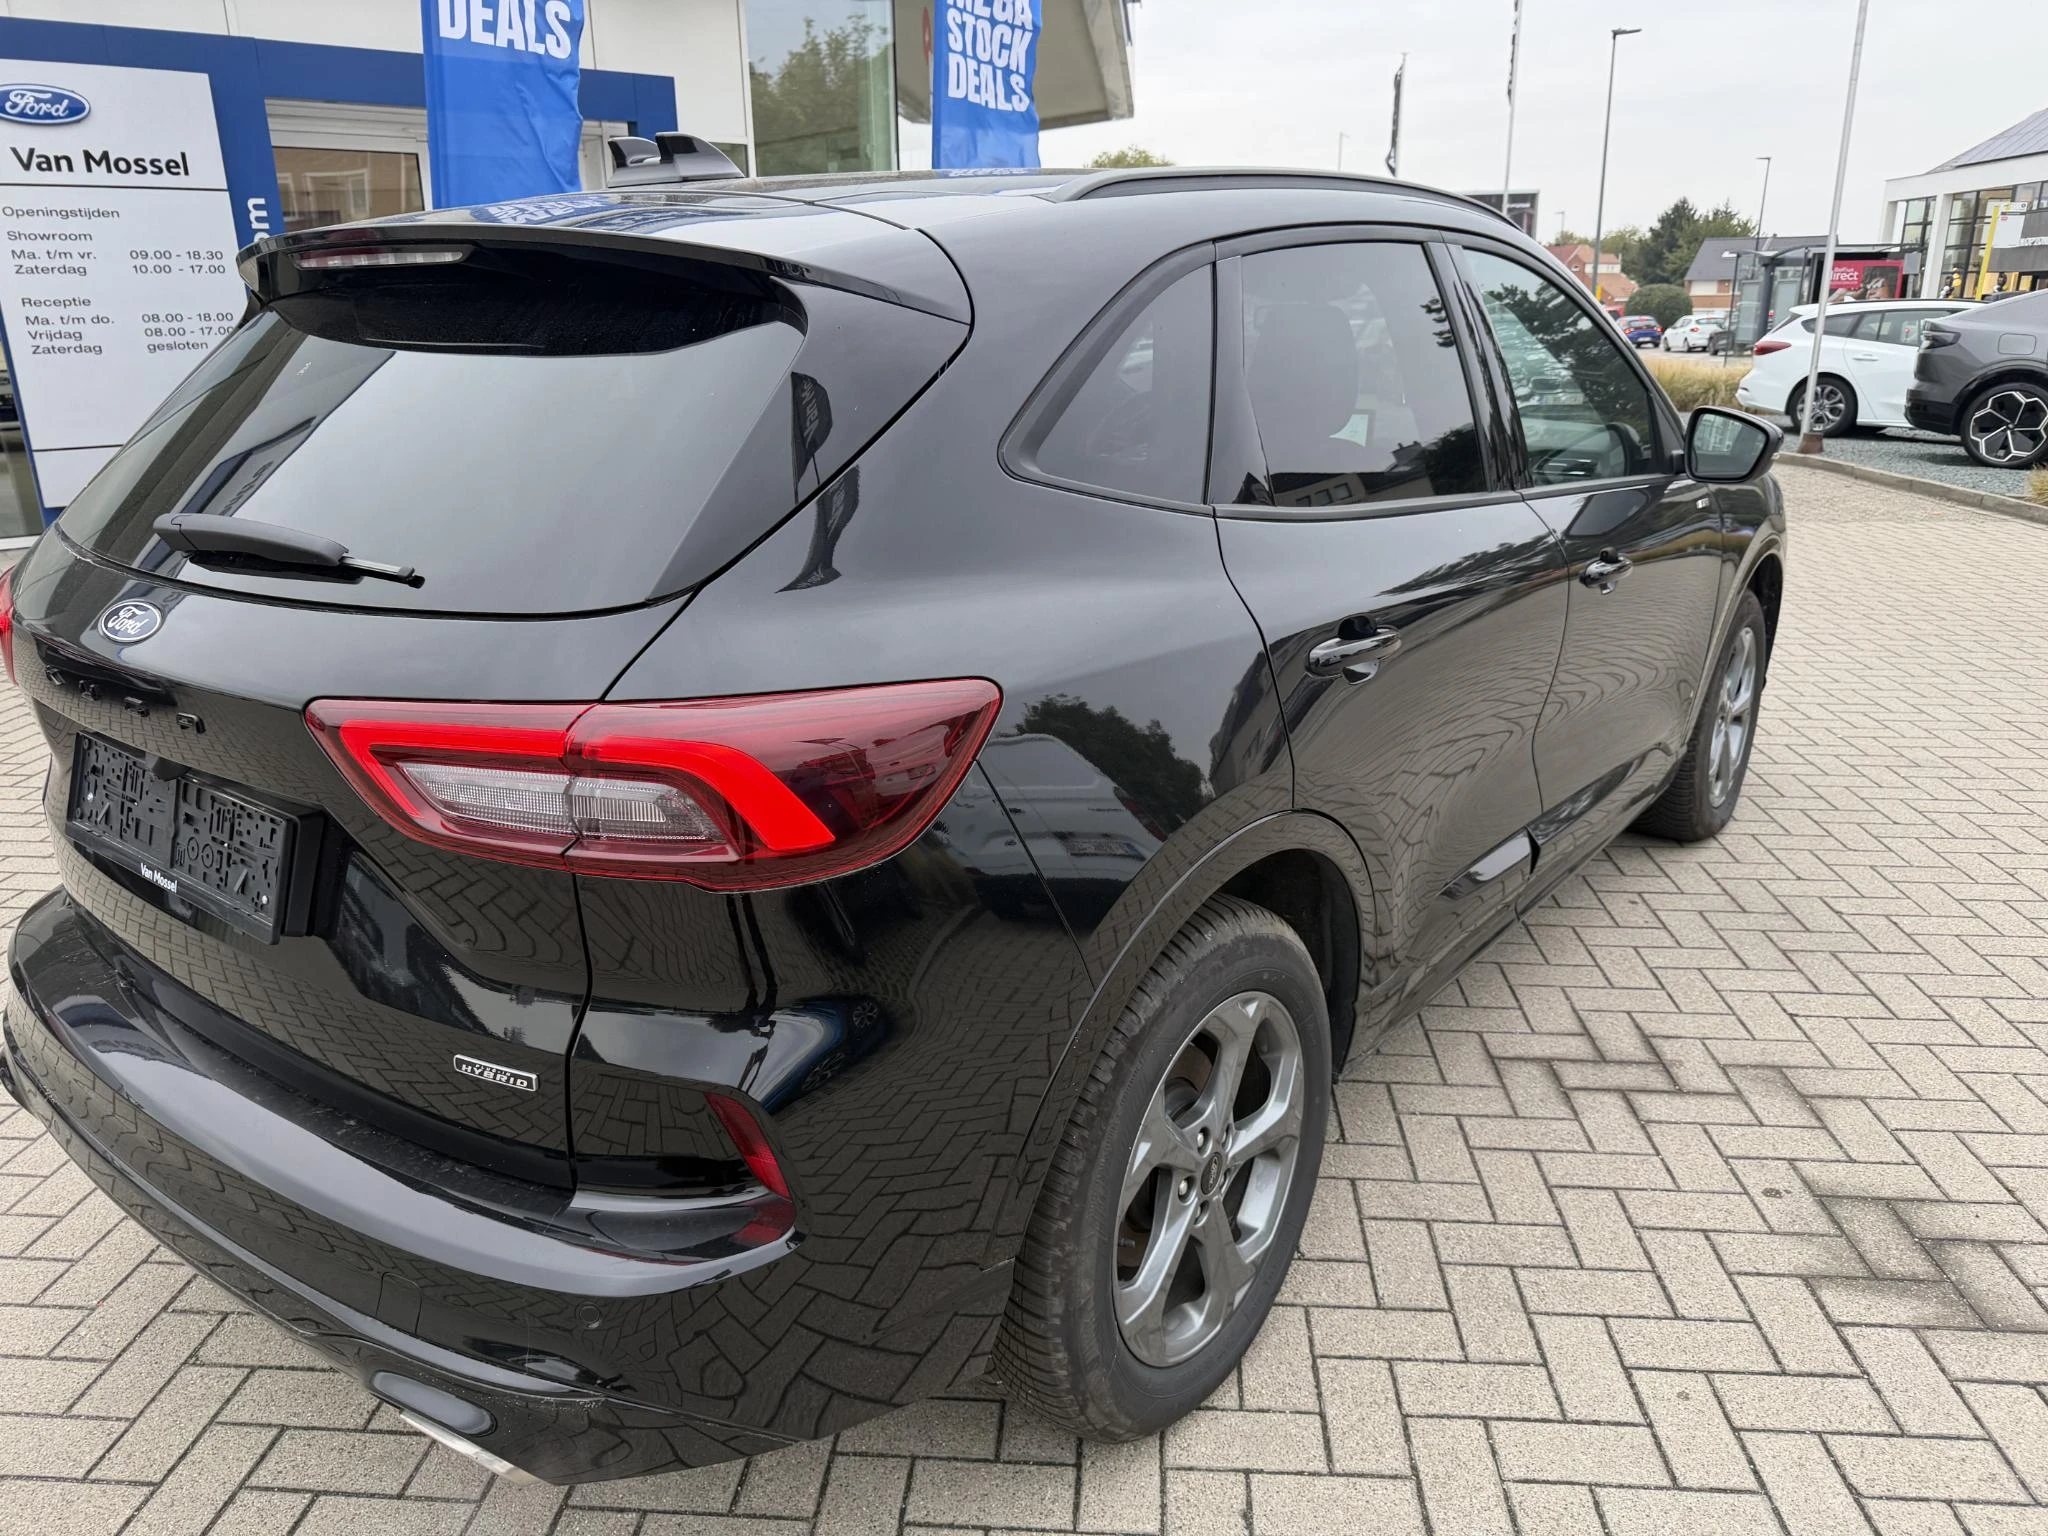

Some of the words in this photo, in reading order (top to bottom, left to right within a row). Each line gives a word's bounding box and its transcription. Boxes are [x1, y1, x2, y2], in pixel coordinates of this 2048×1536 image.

[946, 0, 1034, 31] GA
[438, 0, 571, 59] DEALS
[946, 7, 1033, 76] STOCK
[947, 52, 1030, 112] DEALS
[4, 89, 70, 117] Ford
[9, 146, 74, 173] Van
[82, 149, 190, 176] Mossel
[2, 206, 120, 220] Openingstijden
[7, 230, 93, 241] Showroom
[11, 249, 41, 260] Ma.
[46, 249, 73, 260] t/m
[77, 251, 97, 260] vr.
[129, 250, 172, 260] 09.00
[186, 250, 224, 260] 18.30
[14, 264, 87, 277] Zaterdag
[132, 264, 172, 275] 10.00
[189, 264, 226, 275] 17.00
[21, 296, 91, 309] Receptie
[25, 315, 55, 326] Ma.
[60, 315, 86, 325] t/m
[91, 314, 115, 324] do.
[141, 313, 184, 323] 08.00
[196, 312, 234, 322] 18.00
[27, 329, 83, 342] Vrijdag
[144, 327, 186, 337] 08.00
[31, 343, 103, 355] Zaterdag
[147, 341, 209, 354] gesloten
[107, 606, 149, 635] Ford
[140, 862, 153, 881] Van
[153, 870, 178, 894] Mossel
[461, 1064, 528, 1088] HYBRID
